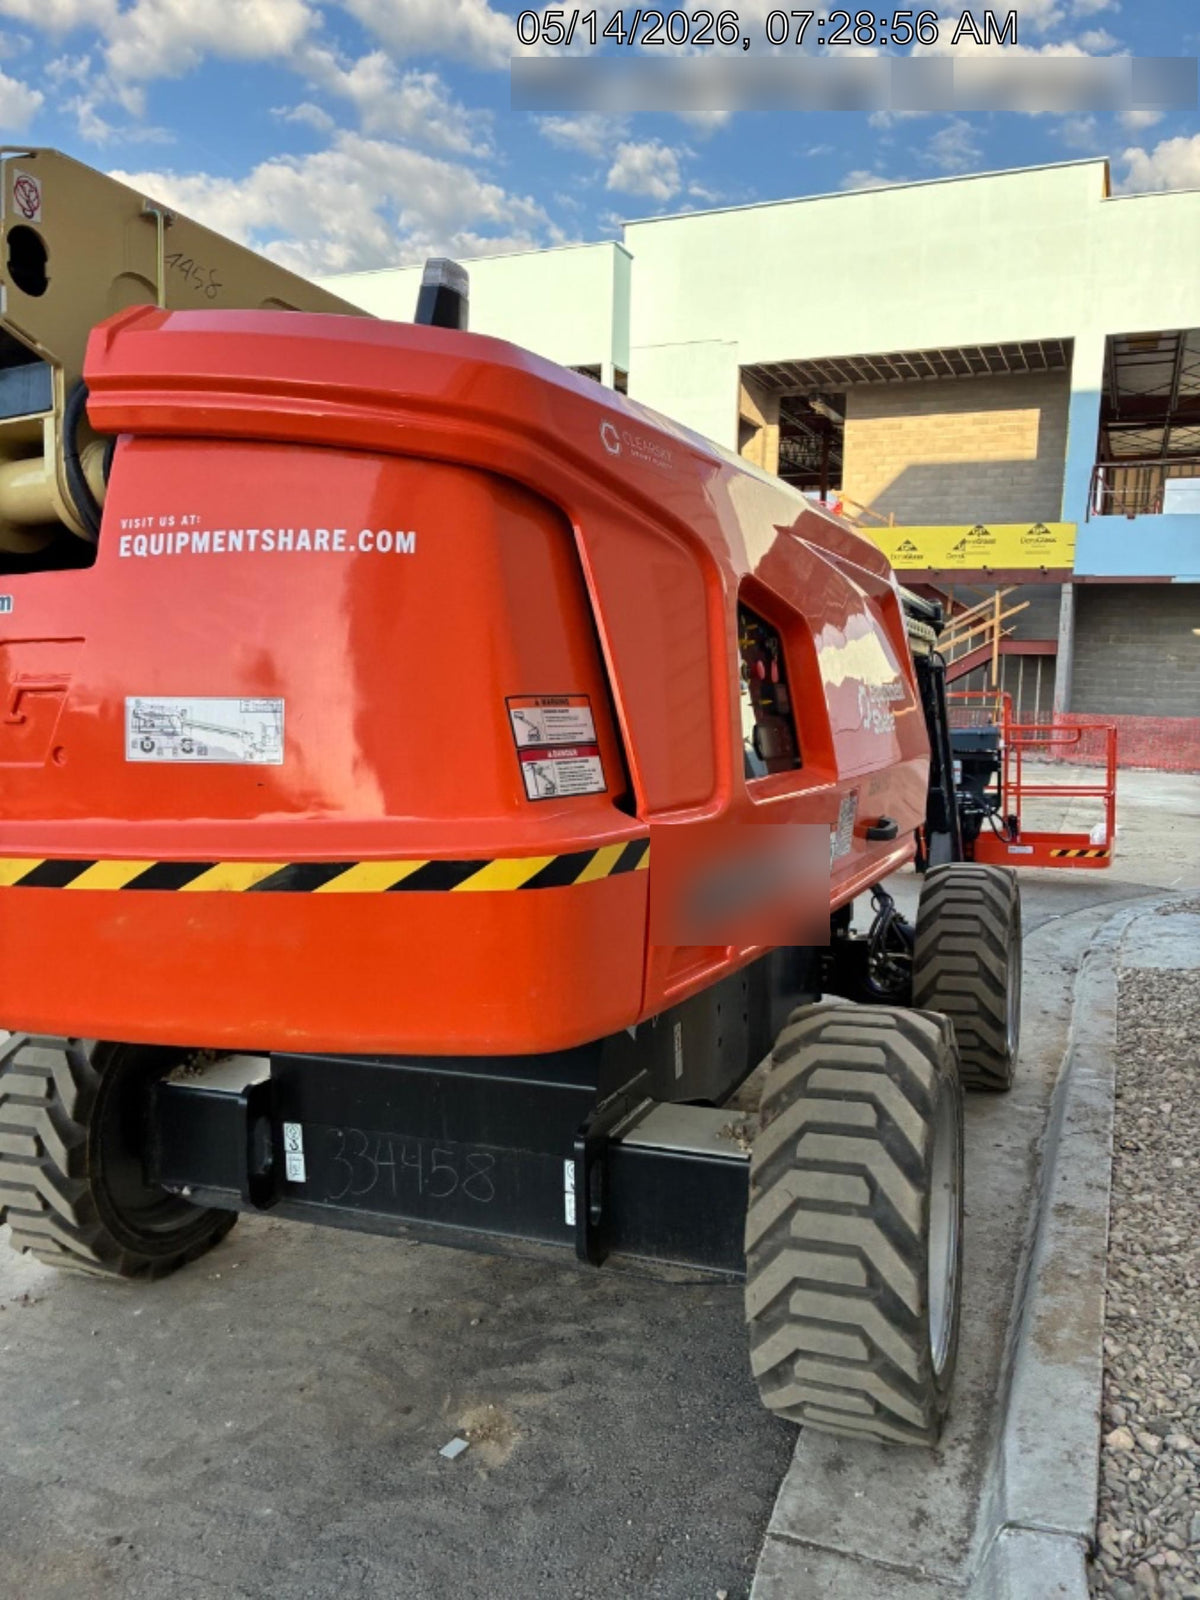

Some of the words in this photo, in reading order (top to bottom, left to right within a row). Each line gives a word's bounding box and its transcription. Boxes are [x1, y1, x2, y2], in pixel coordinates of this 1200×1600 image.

[120, 516, 154, 529] VISIT
[159, 515, 176, 527] US
[180, 514, 202, 526] AT:
[119, 528, 416, 558] EQUIPMENTSHARE.COM
